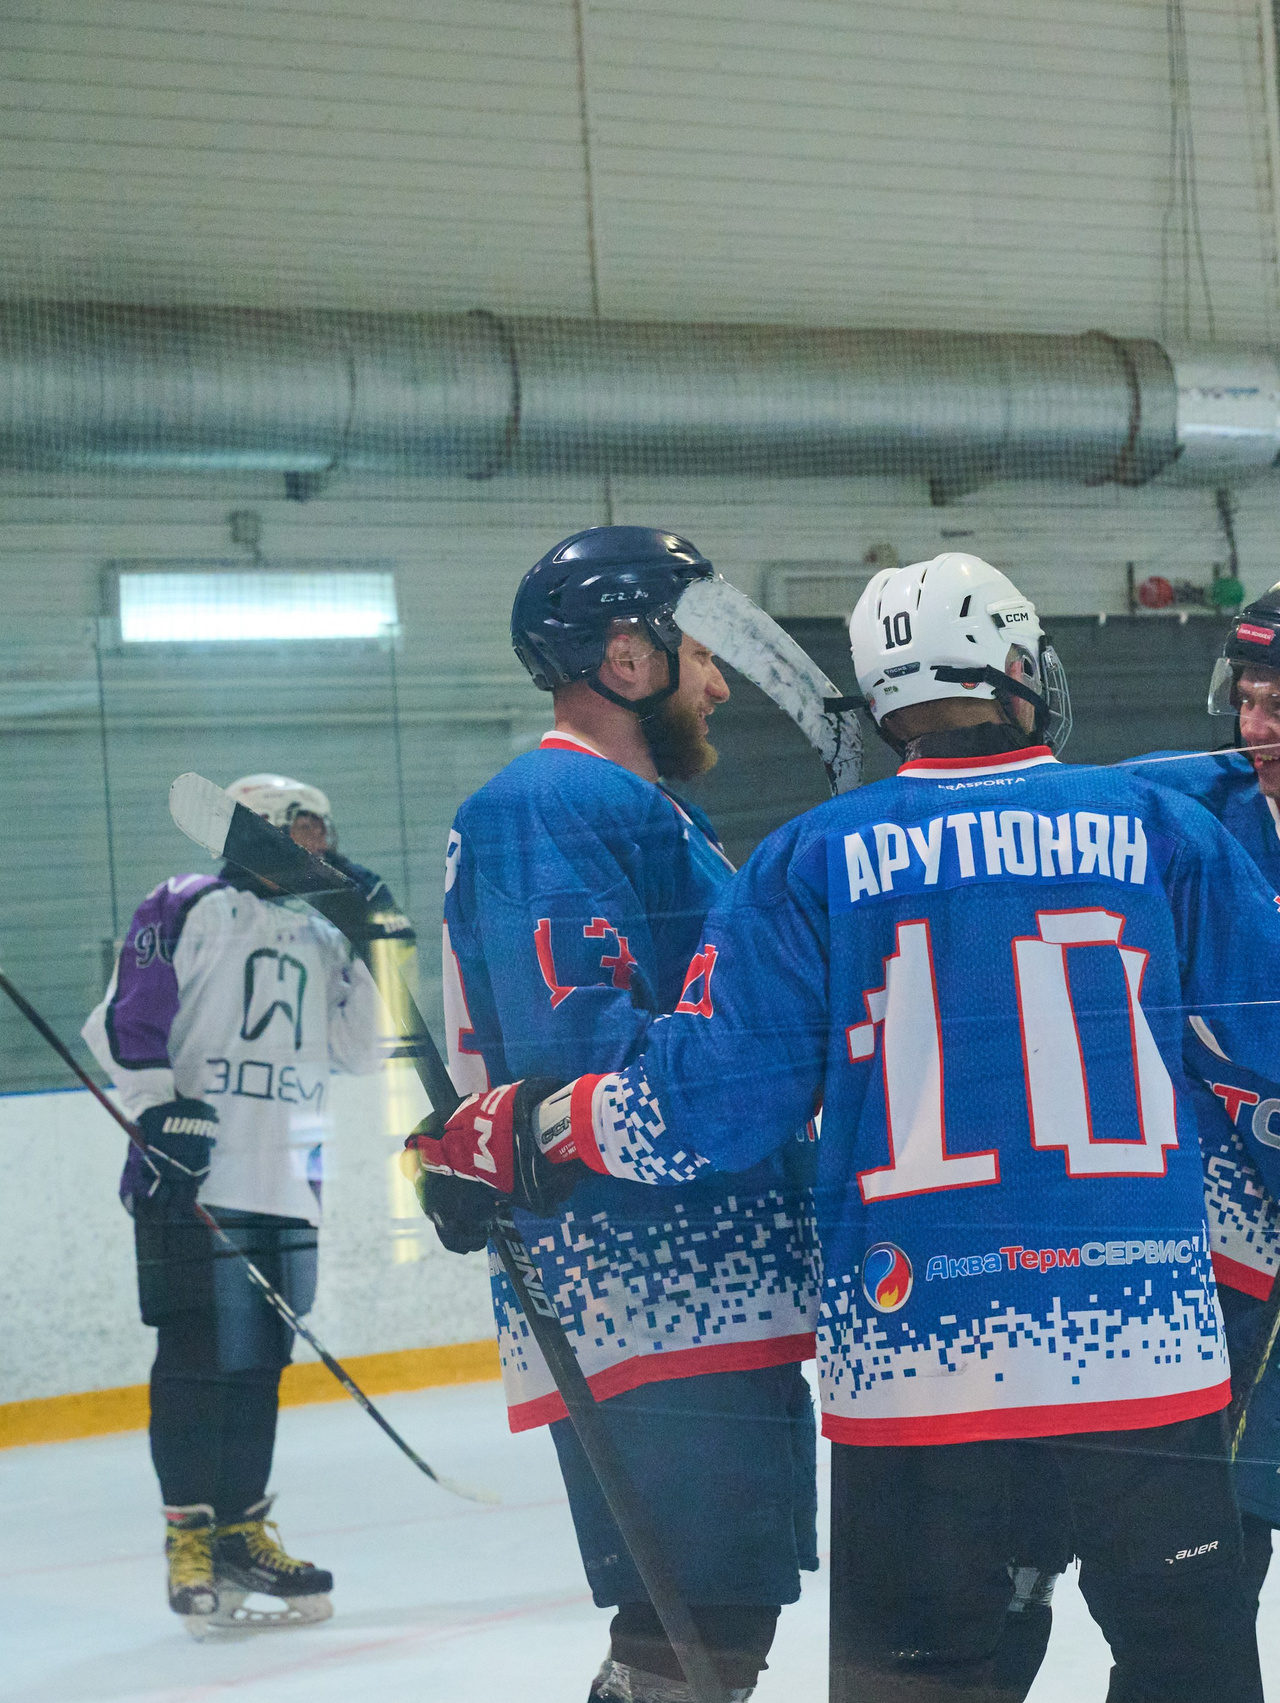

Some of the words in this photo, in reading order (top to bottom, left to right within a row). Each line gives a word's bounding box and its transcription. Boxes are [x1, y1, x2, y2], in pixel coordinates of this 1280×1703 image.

[882, 611, 912, 650] 10
[1005, 612, 1029, 623] CCM
[844, 810, 1148, 903] АРУТЮНЯН
[846, 906, 1180, 1205] 10
